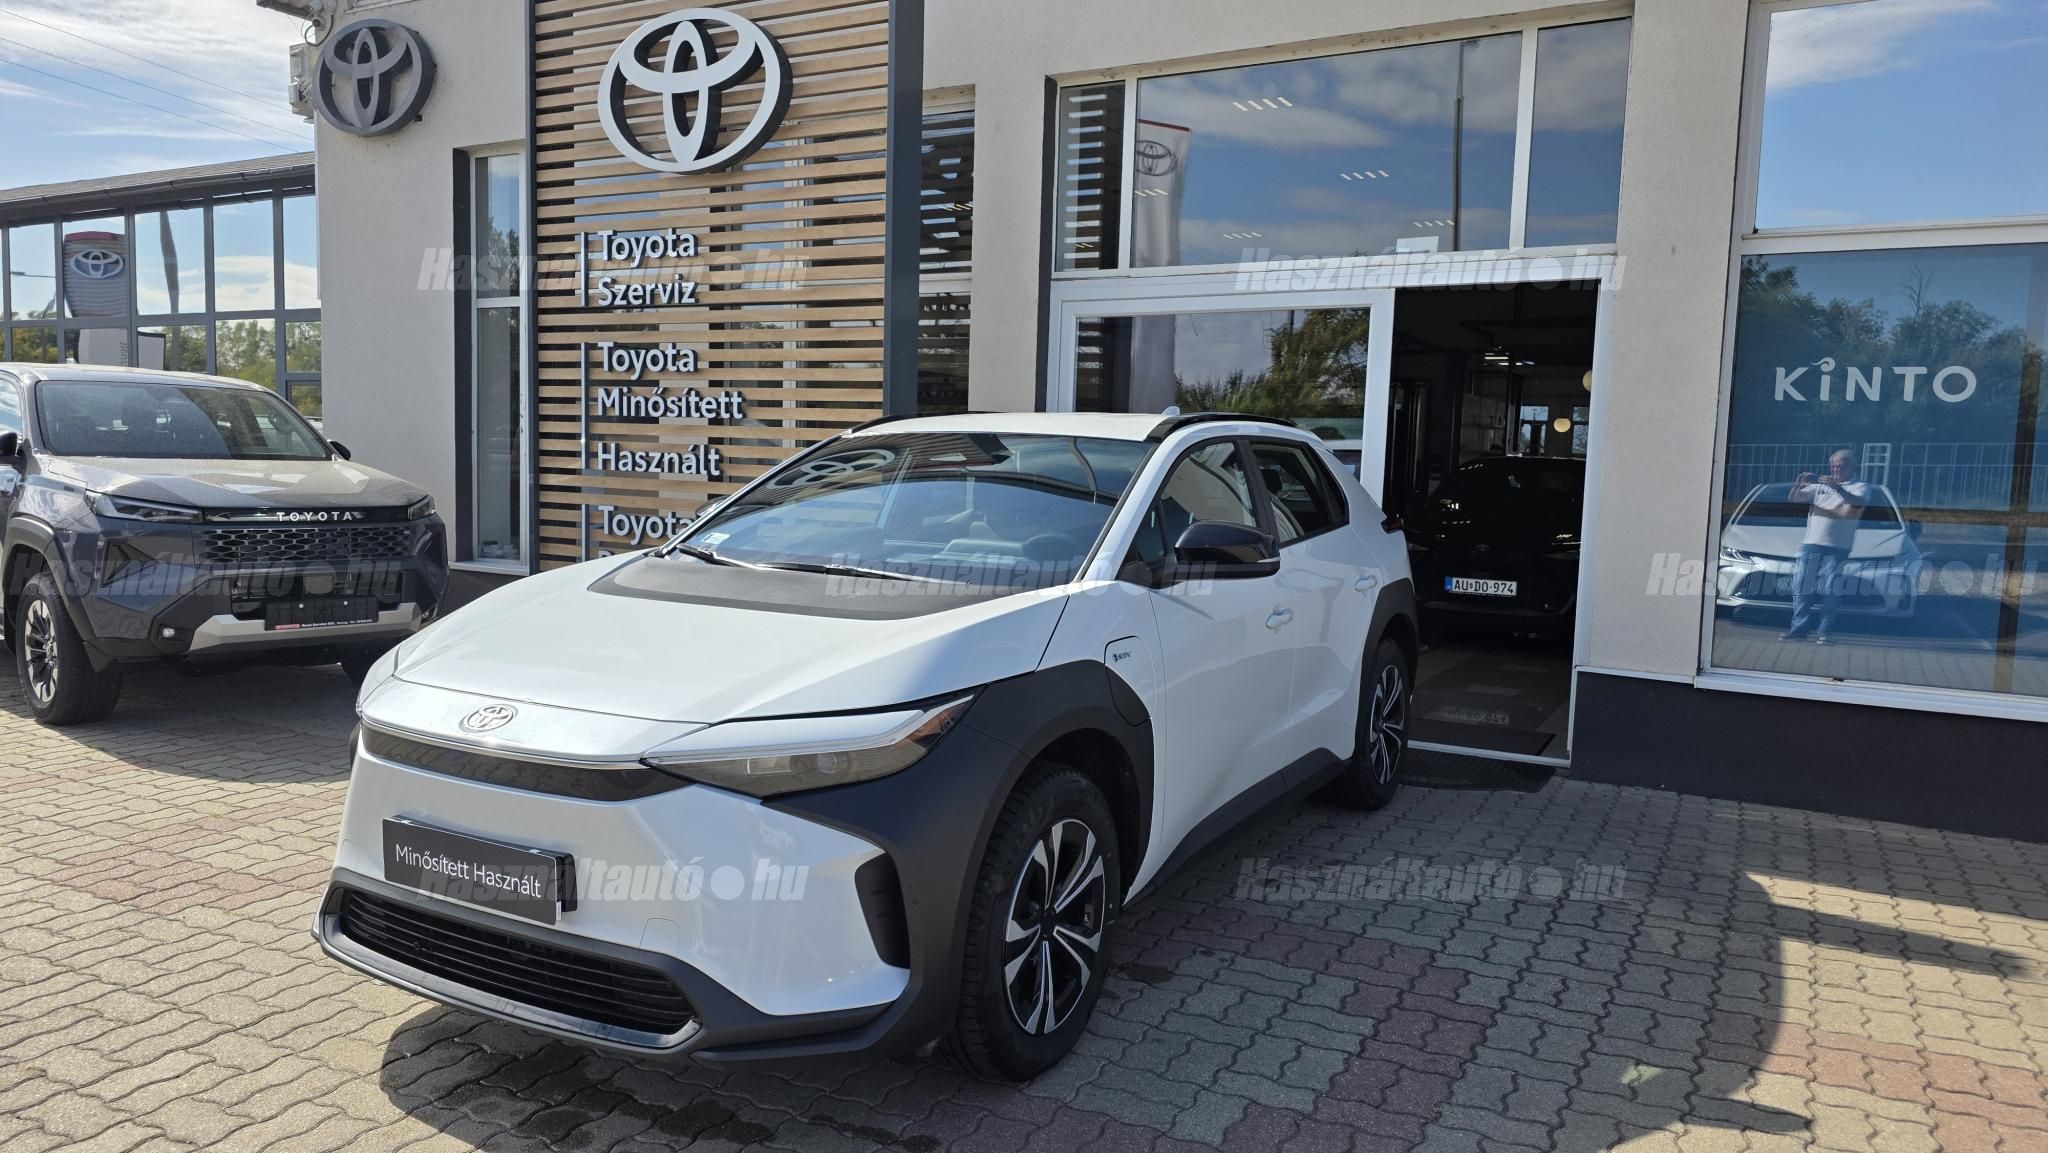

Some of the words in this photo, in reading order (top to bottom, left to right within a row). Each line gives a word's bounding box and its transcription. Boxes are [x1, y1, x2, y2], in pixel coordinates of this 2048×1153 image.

[598, 228, 696, 268] Toyota
[598, 273, 697, 305] Szerviz
[598, 341, 695, 380] Toyota
[598, 387, 743, 419] Minősített
[598, 442, 720, 476] Használt
[276, 511, 353, 521] TOYOTA
[395, 844, 470, 880] Minősített
[474, 863, 542, 898] Használt
